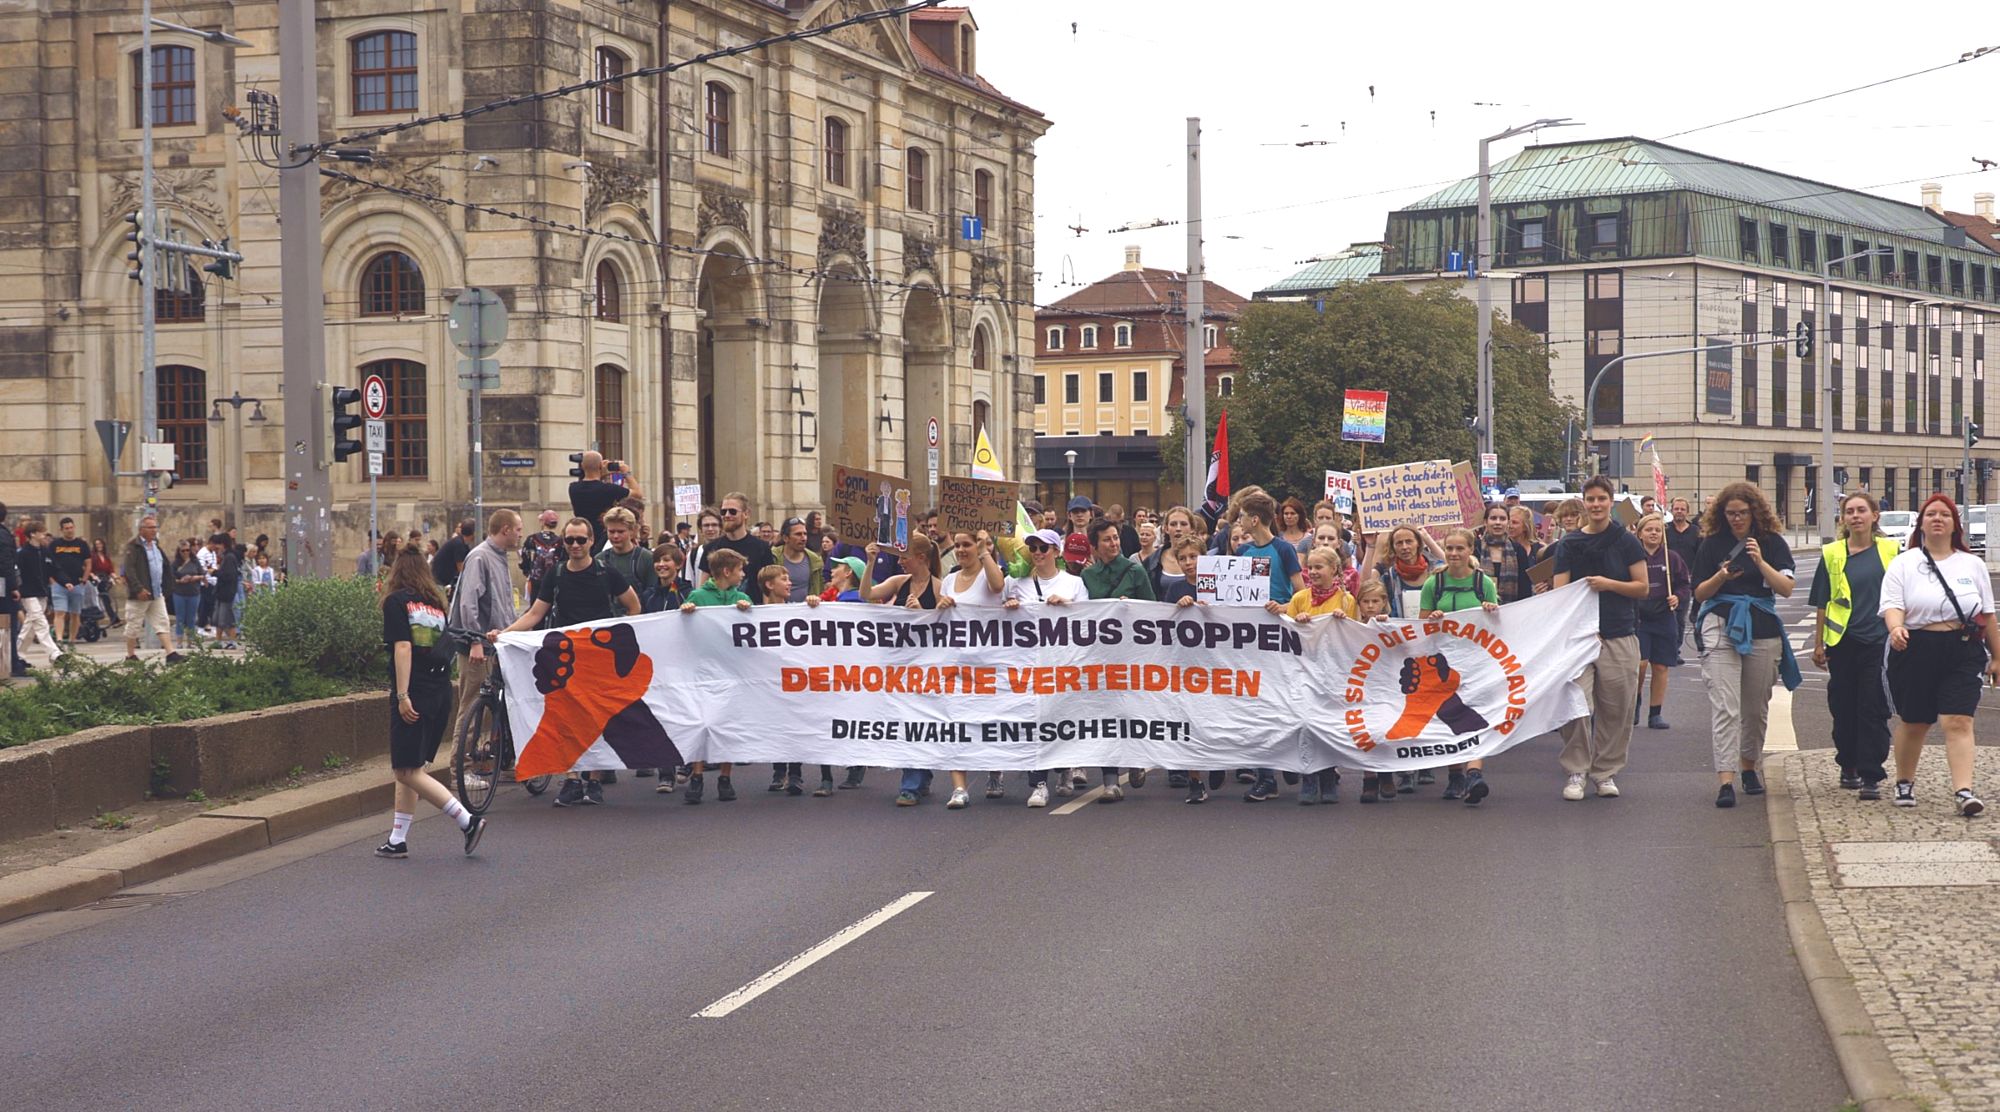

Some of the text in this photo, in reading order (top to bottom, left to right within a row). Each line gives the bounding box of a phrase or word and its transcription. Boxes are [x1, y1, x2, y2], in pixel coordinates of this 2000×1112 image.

[368, 425, 383, 438] TAXI
[836, 468, 869, 491] Conni
[1327, 476, 1352, 491] EKEL
[1357, 469, 1453, 489] Es ist auch dein
[942, 493, 983, 508] rechte
[1361, 481, 1446, 502] Land steh auf
[835, 501, 852, 515] mit
[940, 504, 978, 517] rechte
[1363, 496, 1457, 513] und hilf dass blinder
[947, 515, 1001, 532] Menschen
[1364, 515, 1390, 529] Hass
[1391, 518, 1405, 526] es
[1406, 512, 1426, 525] nicht
[1429, 511, 1461, 522] zerstört
[732, 617, 1302, 656] RECHTSEXTREMISMUS STOPPEN
[781, 664, 1260, 697] DEMOKRATIE VERTEIDIGEN
[1345, 620, 1527, 752] WIR SIND DIE BRANDMAUER
[832, 718, 1191, 743] DIESE WAHL ENTSCHEIDET!
[1397, 735, 1480, 758] DRESDEN
